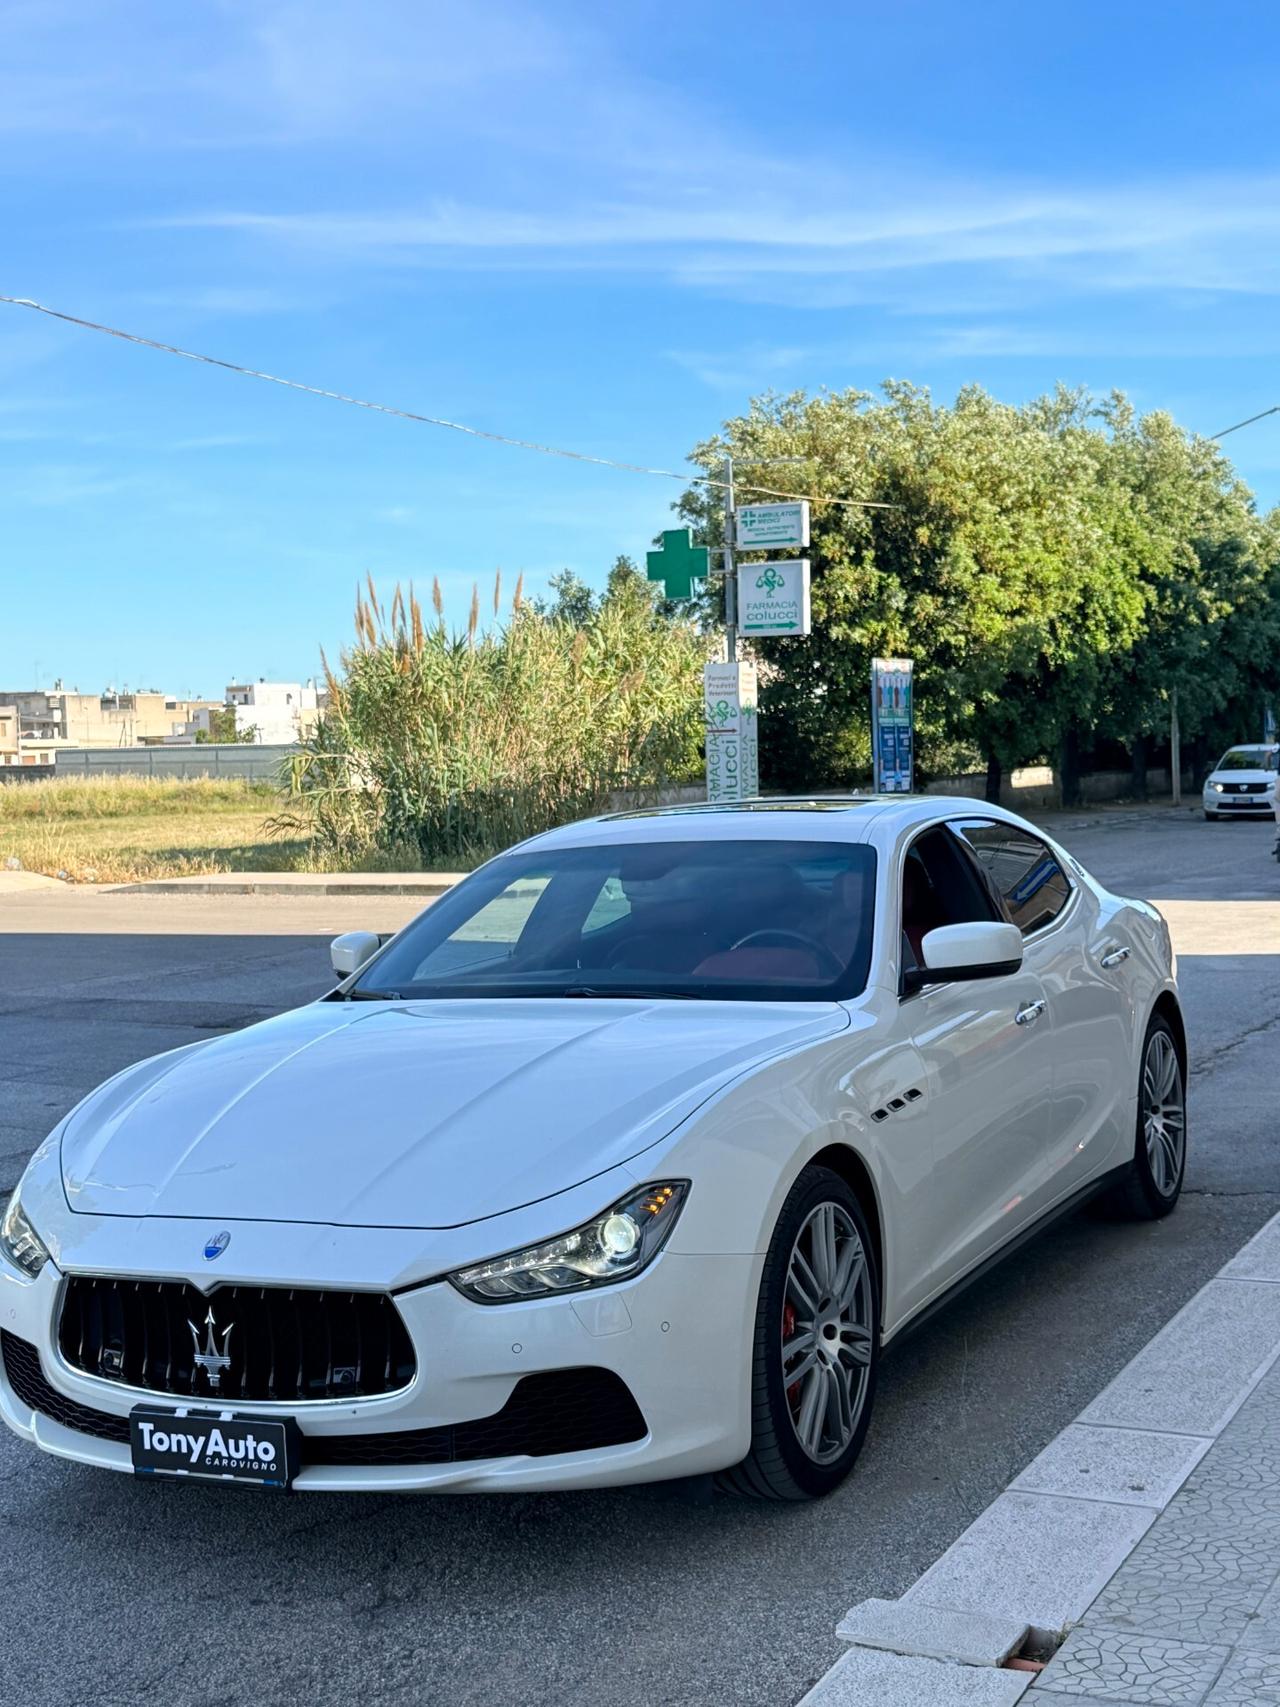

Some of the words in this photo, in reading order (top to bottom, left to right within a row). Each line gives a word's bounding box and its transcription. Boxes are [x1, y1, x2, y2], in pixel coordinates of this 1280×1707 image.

[746, 601, 798, 610] FARMACIA
[746, 609, 798, 621] colucci
[709, 734, 721, 801] RMACIA
[721, 740, 738, 800] lucci
[138, 1422, 276, 1463] TonyAuto
[205, 1457, 277, 1471] CAROVIGNO
